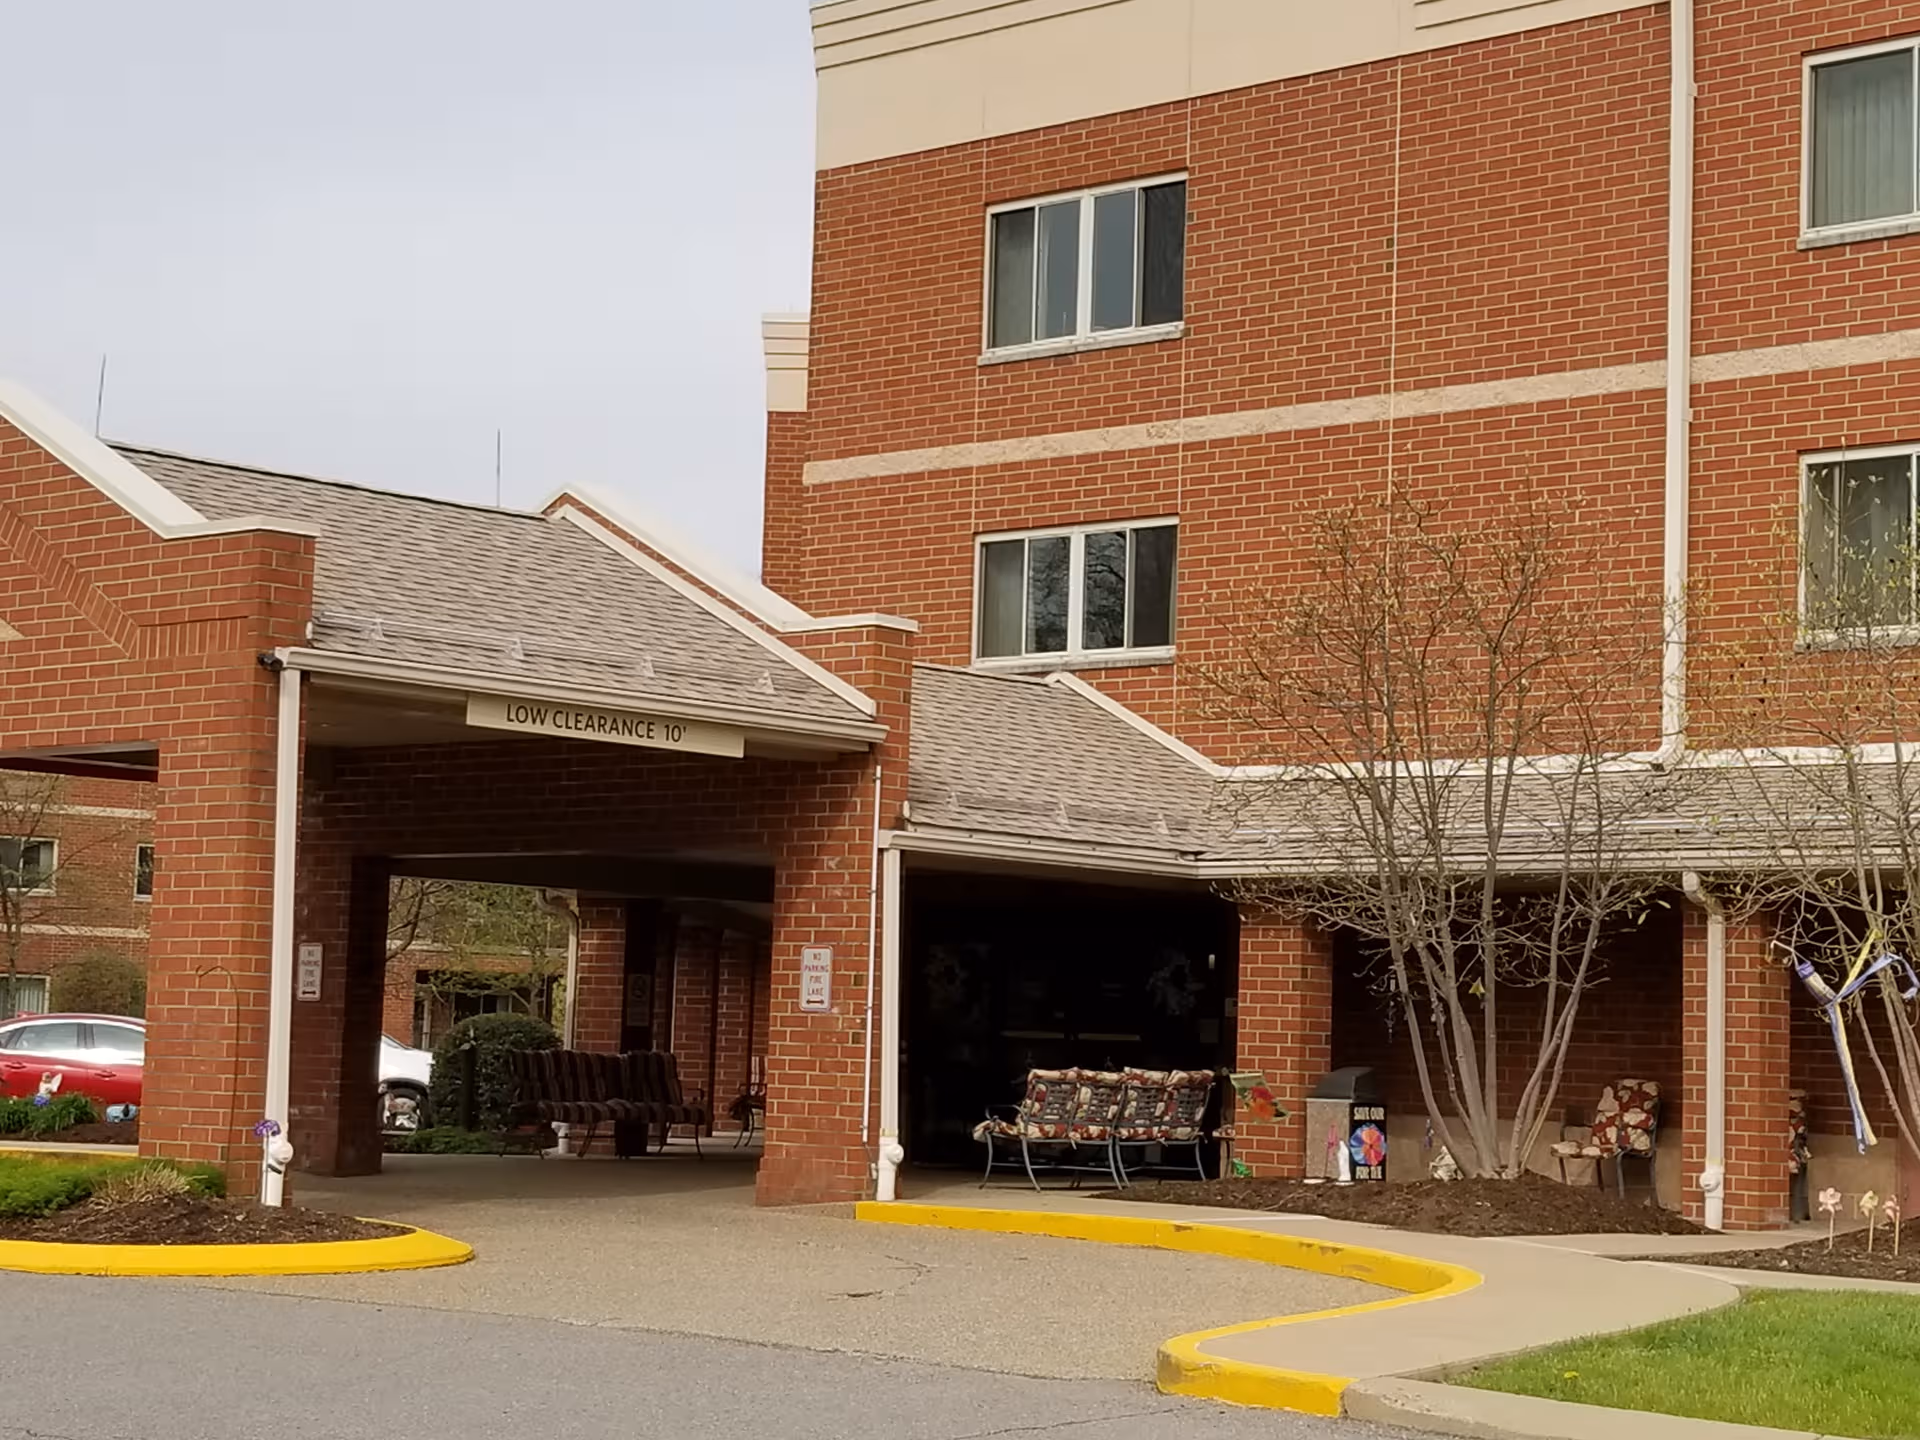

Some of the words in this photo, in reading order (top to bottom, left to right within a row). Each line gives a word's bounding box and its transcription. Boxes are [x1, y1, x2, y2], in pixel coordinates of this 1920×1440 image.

[507, 704, 548, 726] LOW
[552, 710, 655, 739] CLEARANCE
[664, 724, 687, 743] 10'
[1354, 1106, 1370, 1120] SAVE
[1370, 1107, 1385, 1120] OUR
